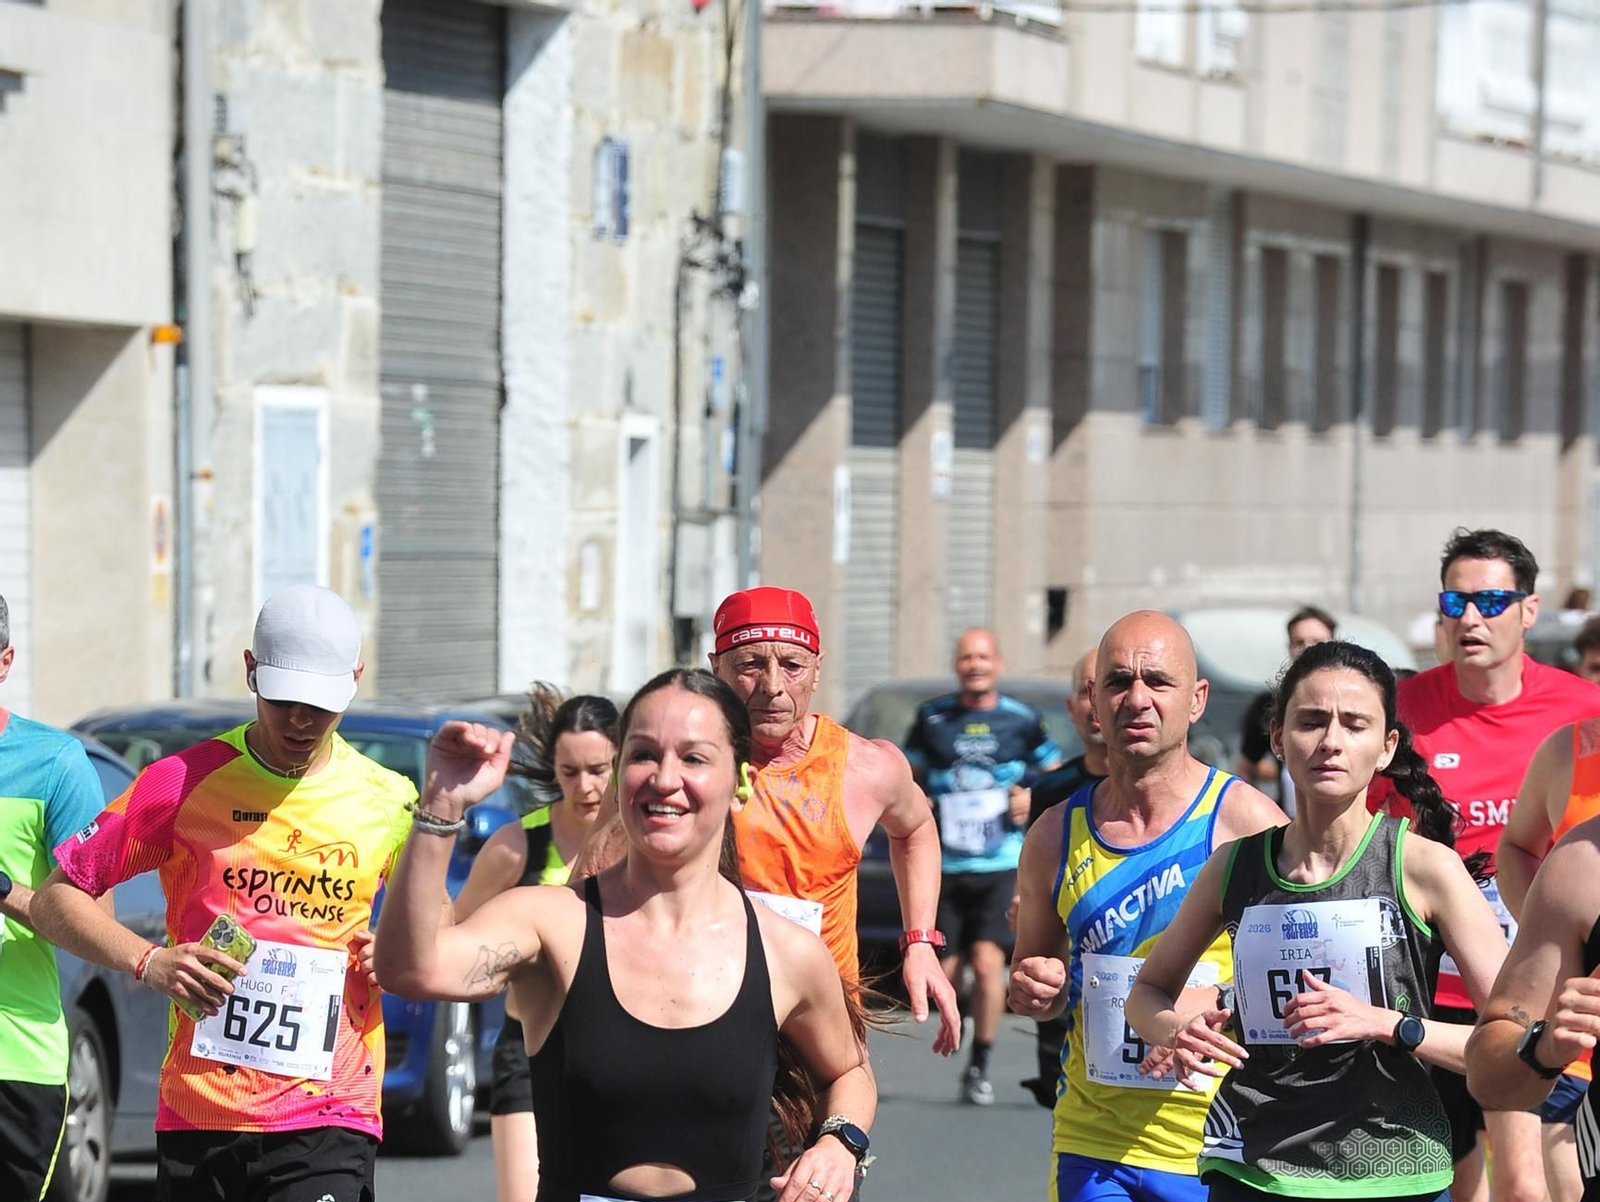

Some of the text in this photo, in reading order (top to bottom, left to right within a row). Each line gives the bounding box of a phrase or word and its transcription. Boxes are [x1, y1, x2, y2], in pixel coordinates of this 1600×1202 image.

[1248, 924, 1271, 933] 2026
[1279, 949, 1312, 961] IRIA
[1094, 971, 1118, 981] 2026
[240, 978, 273, 994] HUGO
[223, 994, 303, 1052] 625
